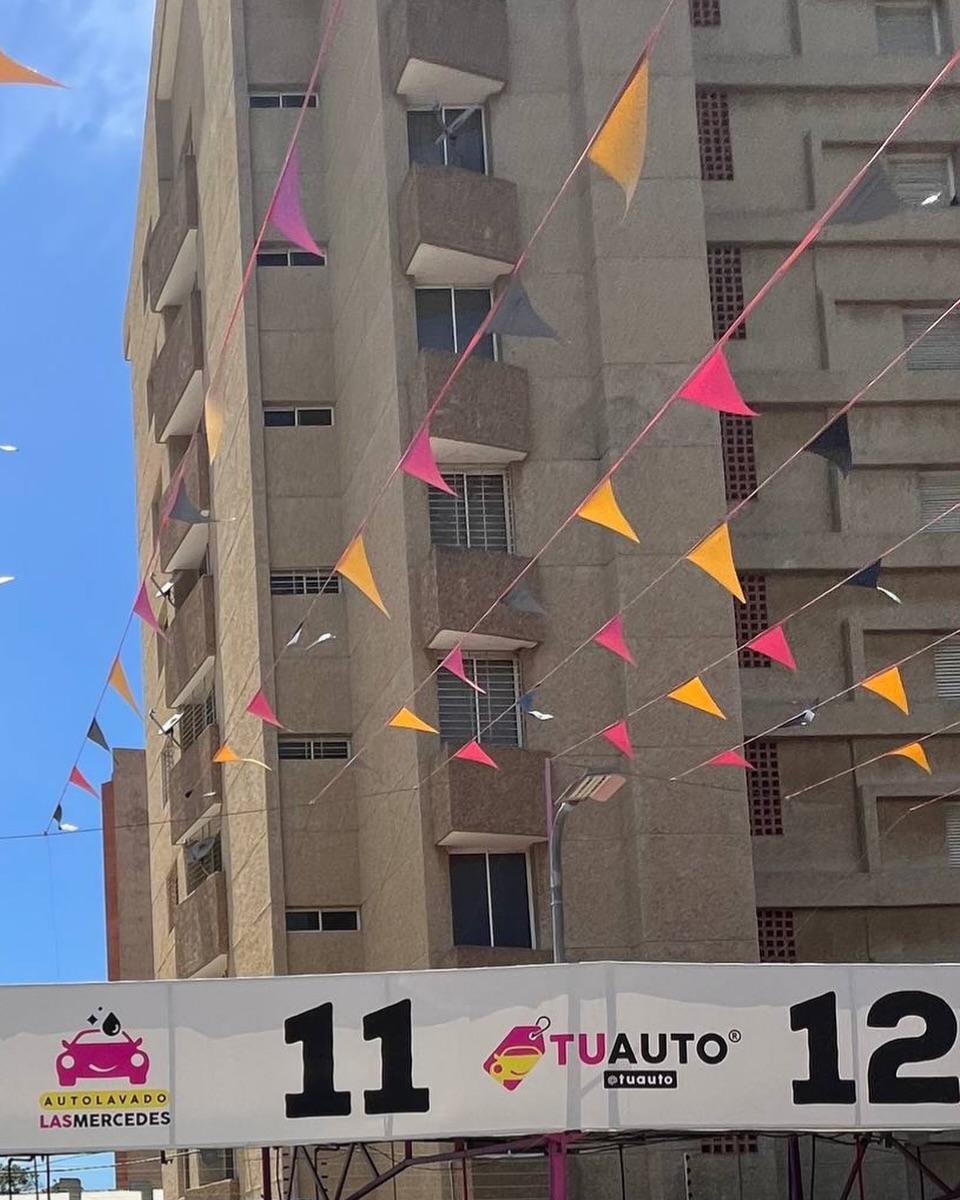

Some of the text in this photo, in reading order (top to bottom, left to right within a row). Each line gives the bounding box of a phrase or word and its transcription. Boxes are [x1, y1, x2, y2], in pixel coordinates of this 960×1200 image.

[284, 998, 429, 1118] 11
[790, 990, 960, 1104] 12
[44, 1093, 167, 1107] AUTOLAVADO
[607, 1073, 673, 1086] @tuauto
